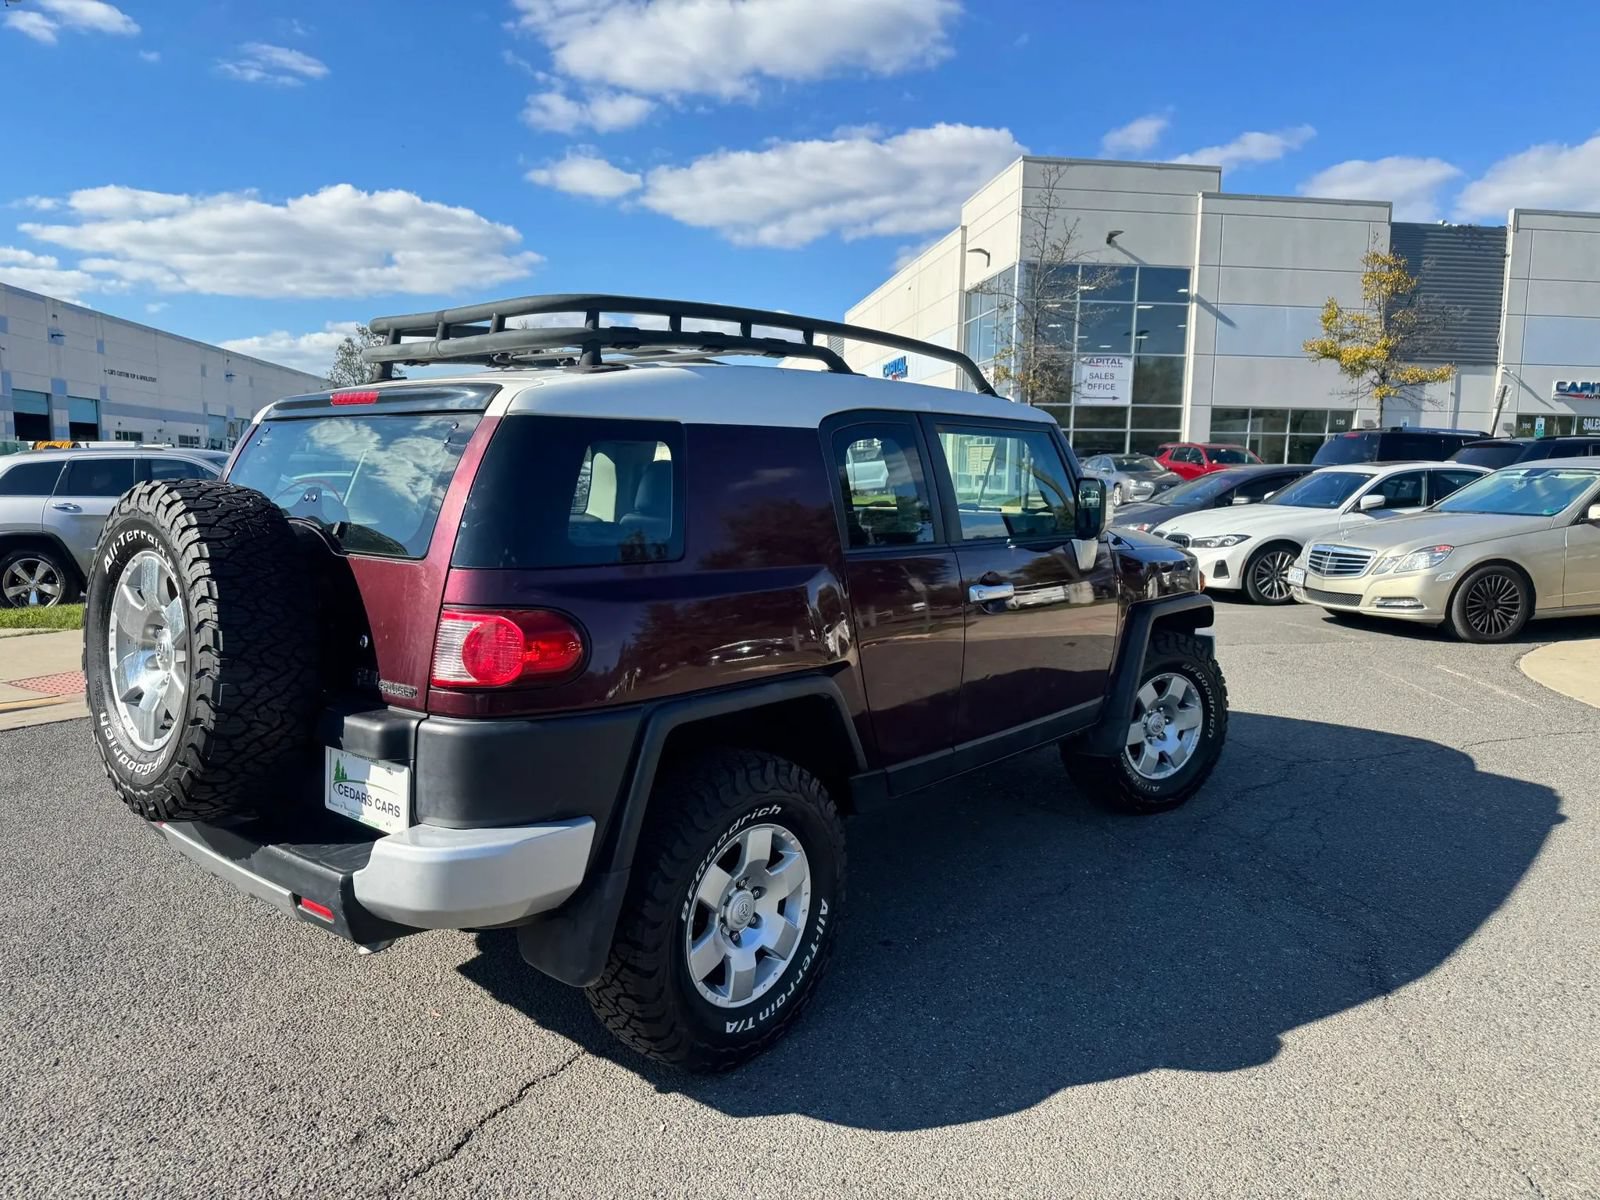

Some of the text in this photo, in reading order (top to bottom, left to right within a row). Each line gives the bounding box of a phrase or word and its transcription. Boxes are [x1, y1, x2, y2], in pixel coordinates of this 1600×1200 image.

[1087, 383, 1116, 391] OFFICE
[1089, 372, 1115, 380] SALES
[1583, 418, 1600, 430] SALE
[104, 529, 165, 575] All-Terrain
[338, 783, 401, 818] CEDARS CARS
[681, 804, 782, 922] BFGoodrich
[725, 898, 829, 1033] All-Terrain T/A
